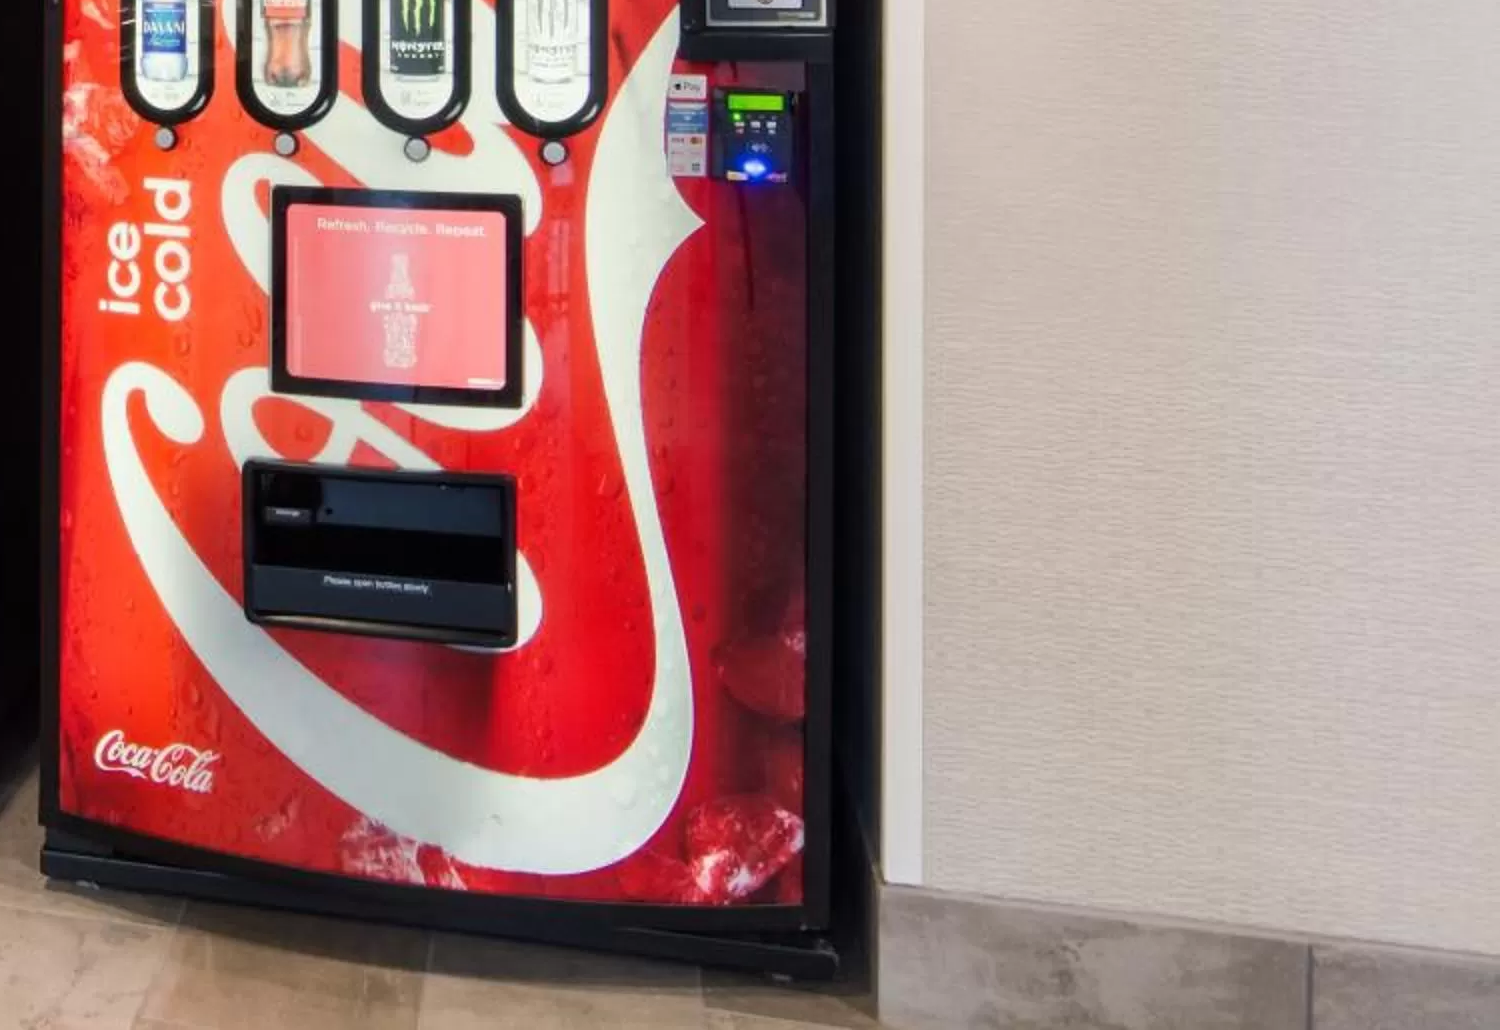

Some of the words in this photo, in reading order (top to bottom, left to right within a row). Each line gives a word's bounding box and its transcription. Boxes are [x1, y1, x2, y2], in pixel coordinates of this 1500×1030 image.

[99, 221, 142, 315] ice
[143, 176, 192, 322] cold
[94, 729, 220, 794] Coca-Cola
